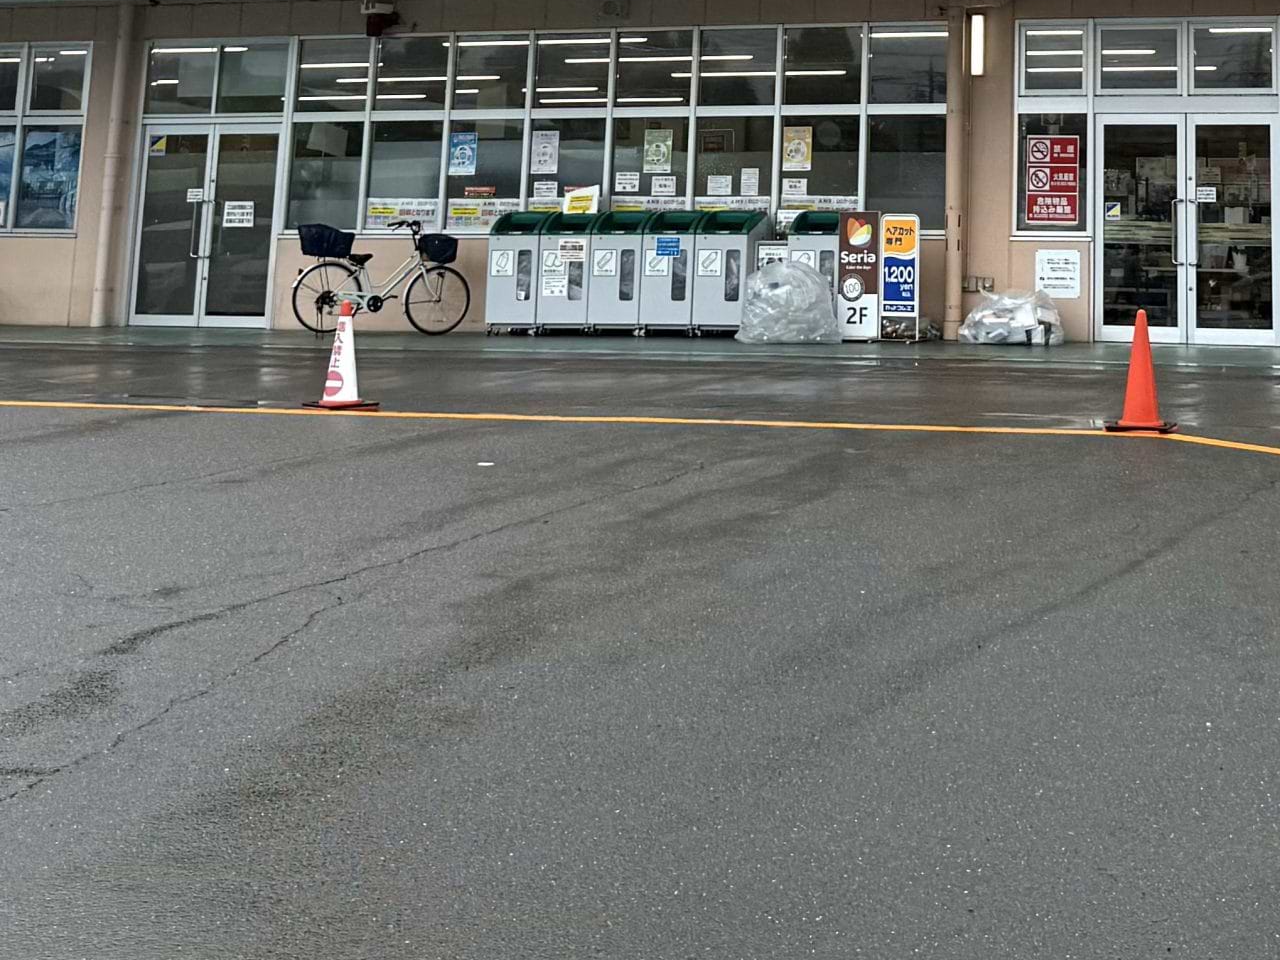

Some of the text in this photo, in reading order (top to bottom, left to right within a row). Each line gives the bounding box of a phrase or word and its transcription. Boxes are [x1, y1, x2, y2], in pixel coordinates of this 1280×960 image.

[886, 226, 915, 236] ヘアカット
[840, 250, 876, 263] Seria
[845, 282, 860, 294] 100
[900, 283, 913, 291] yen
[846, 307, 868, 325] 2F
